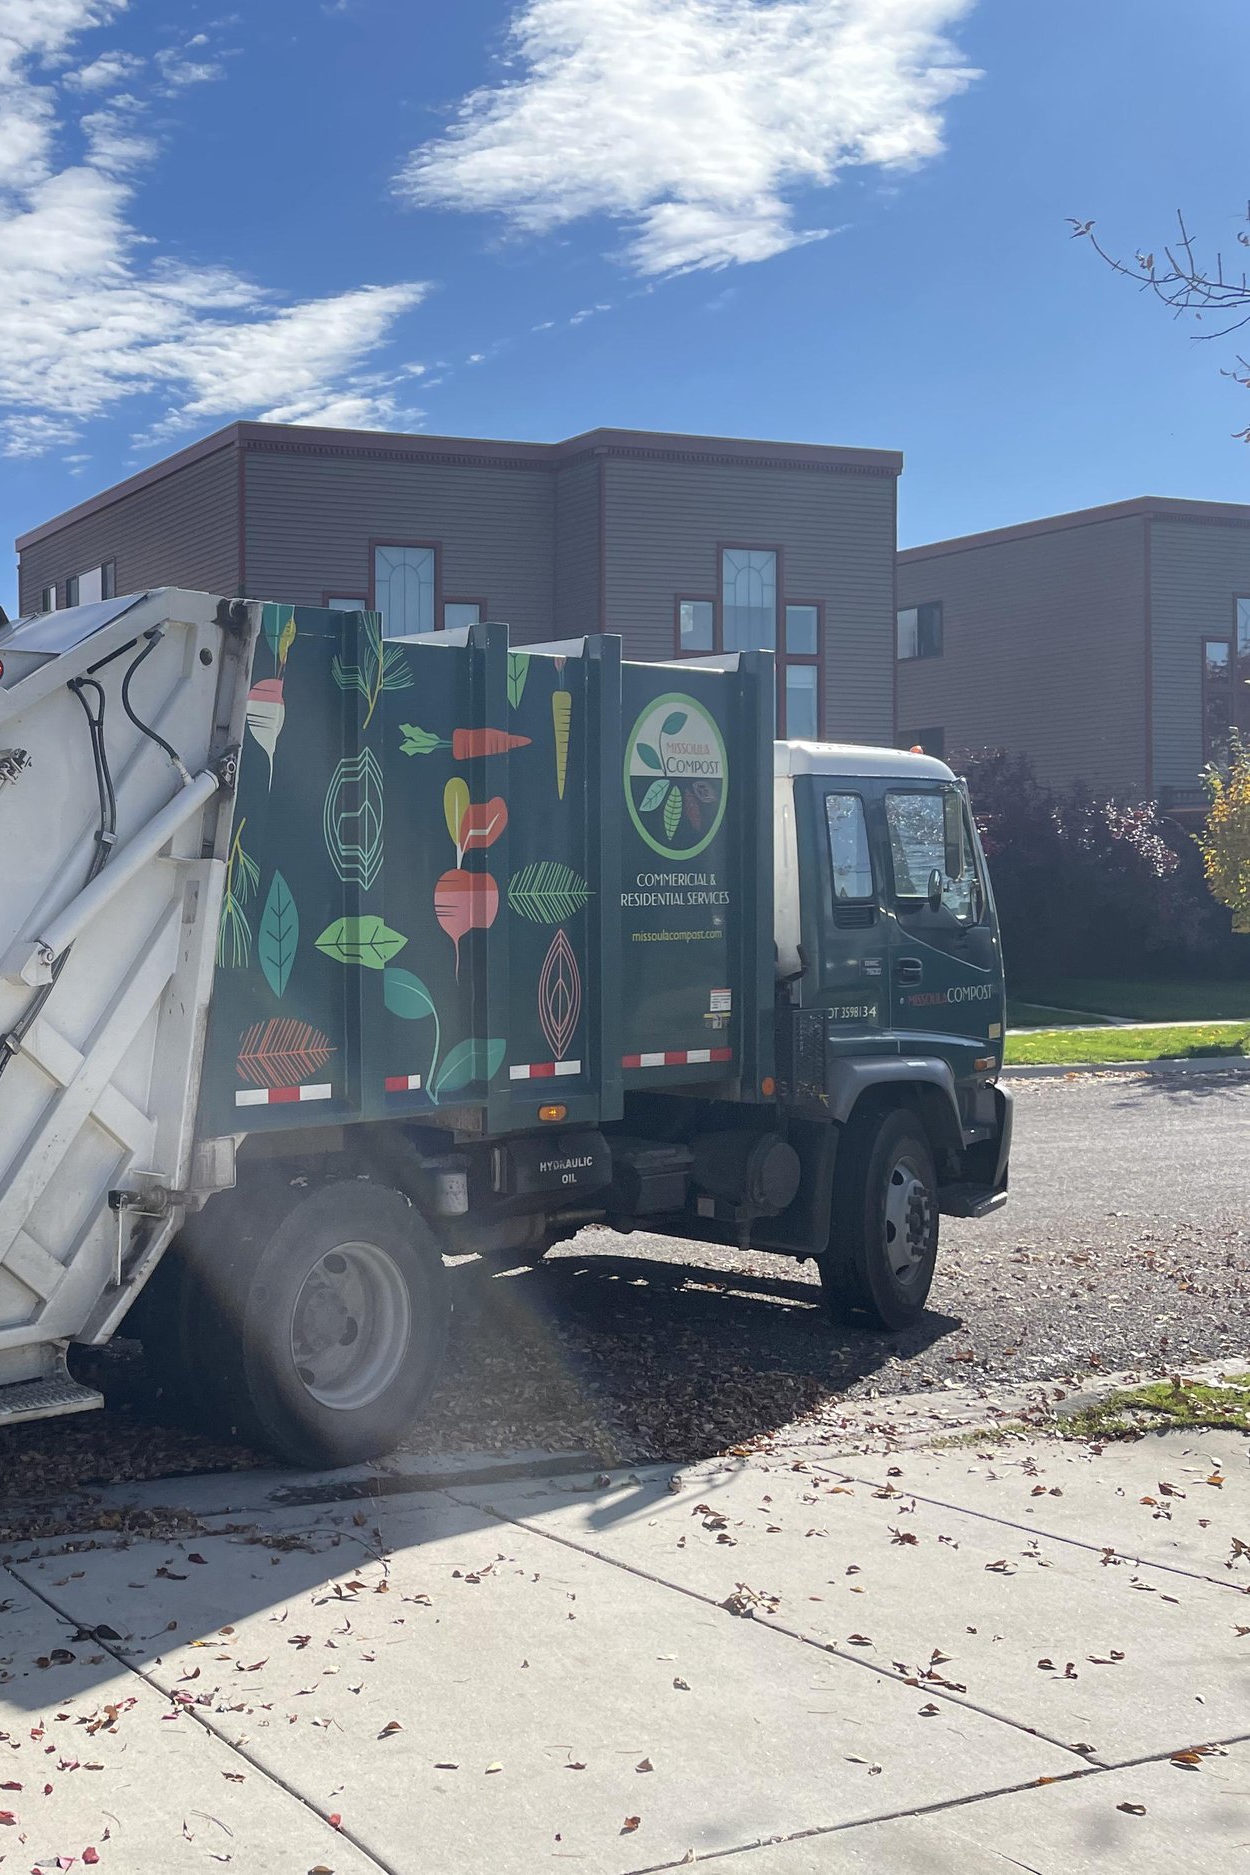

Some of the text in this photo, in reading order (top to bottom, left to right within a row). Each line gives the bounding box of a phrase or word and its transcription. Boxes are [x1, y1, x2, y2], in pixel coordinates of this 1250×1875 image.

[666, 743, 710, 755] MISSOULA
[666, 757, 720, 774] COMPOST
[636, 873, 717, 887] COMMERICIAL &
[620, 891, 730, 906] RESIDENTIAL SERVICES
[632, 929, 723, 943] missoulacompost.com
[840, 1006, 877, 1018] 3598134
[539, 1156, 594, 1172] HYDRAULIC
[561, 1173, 577, 1184] OIL
